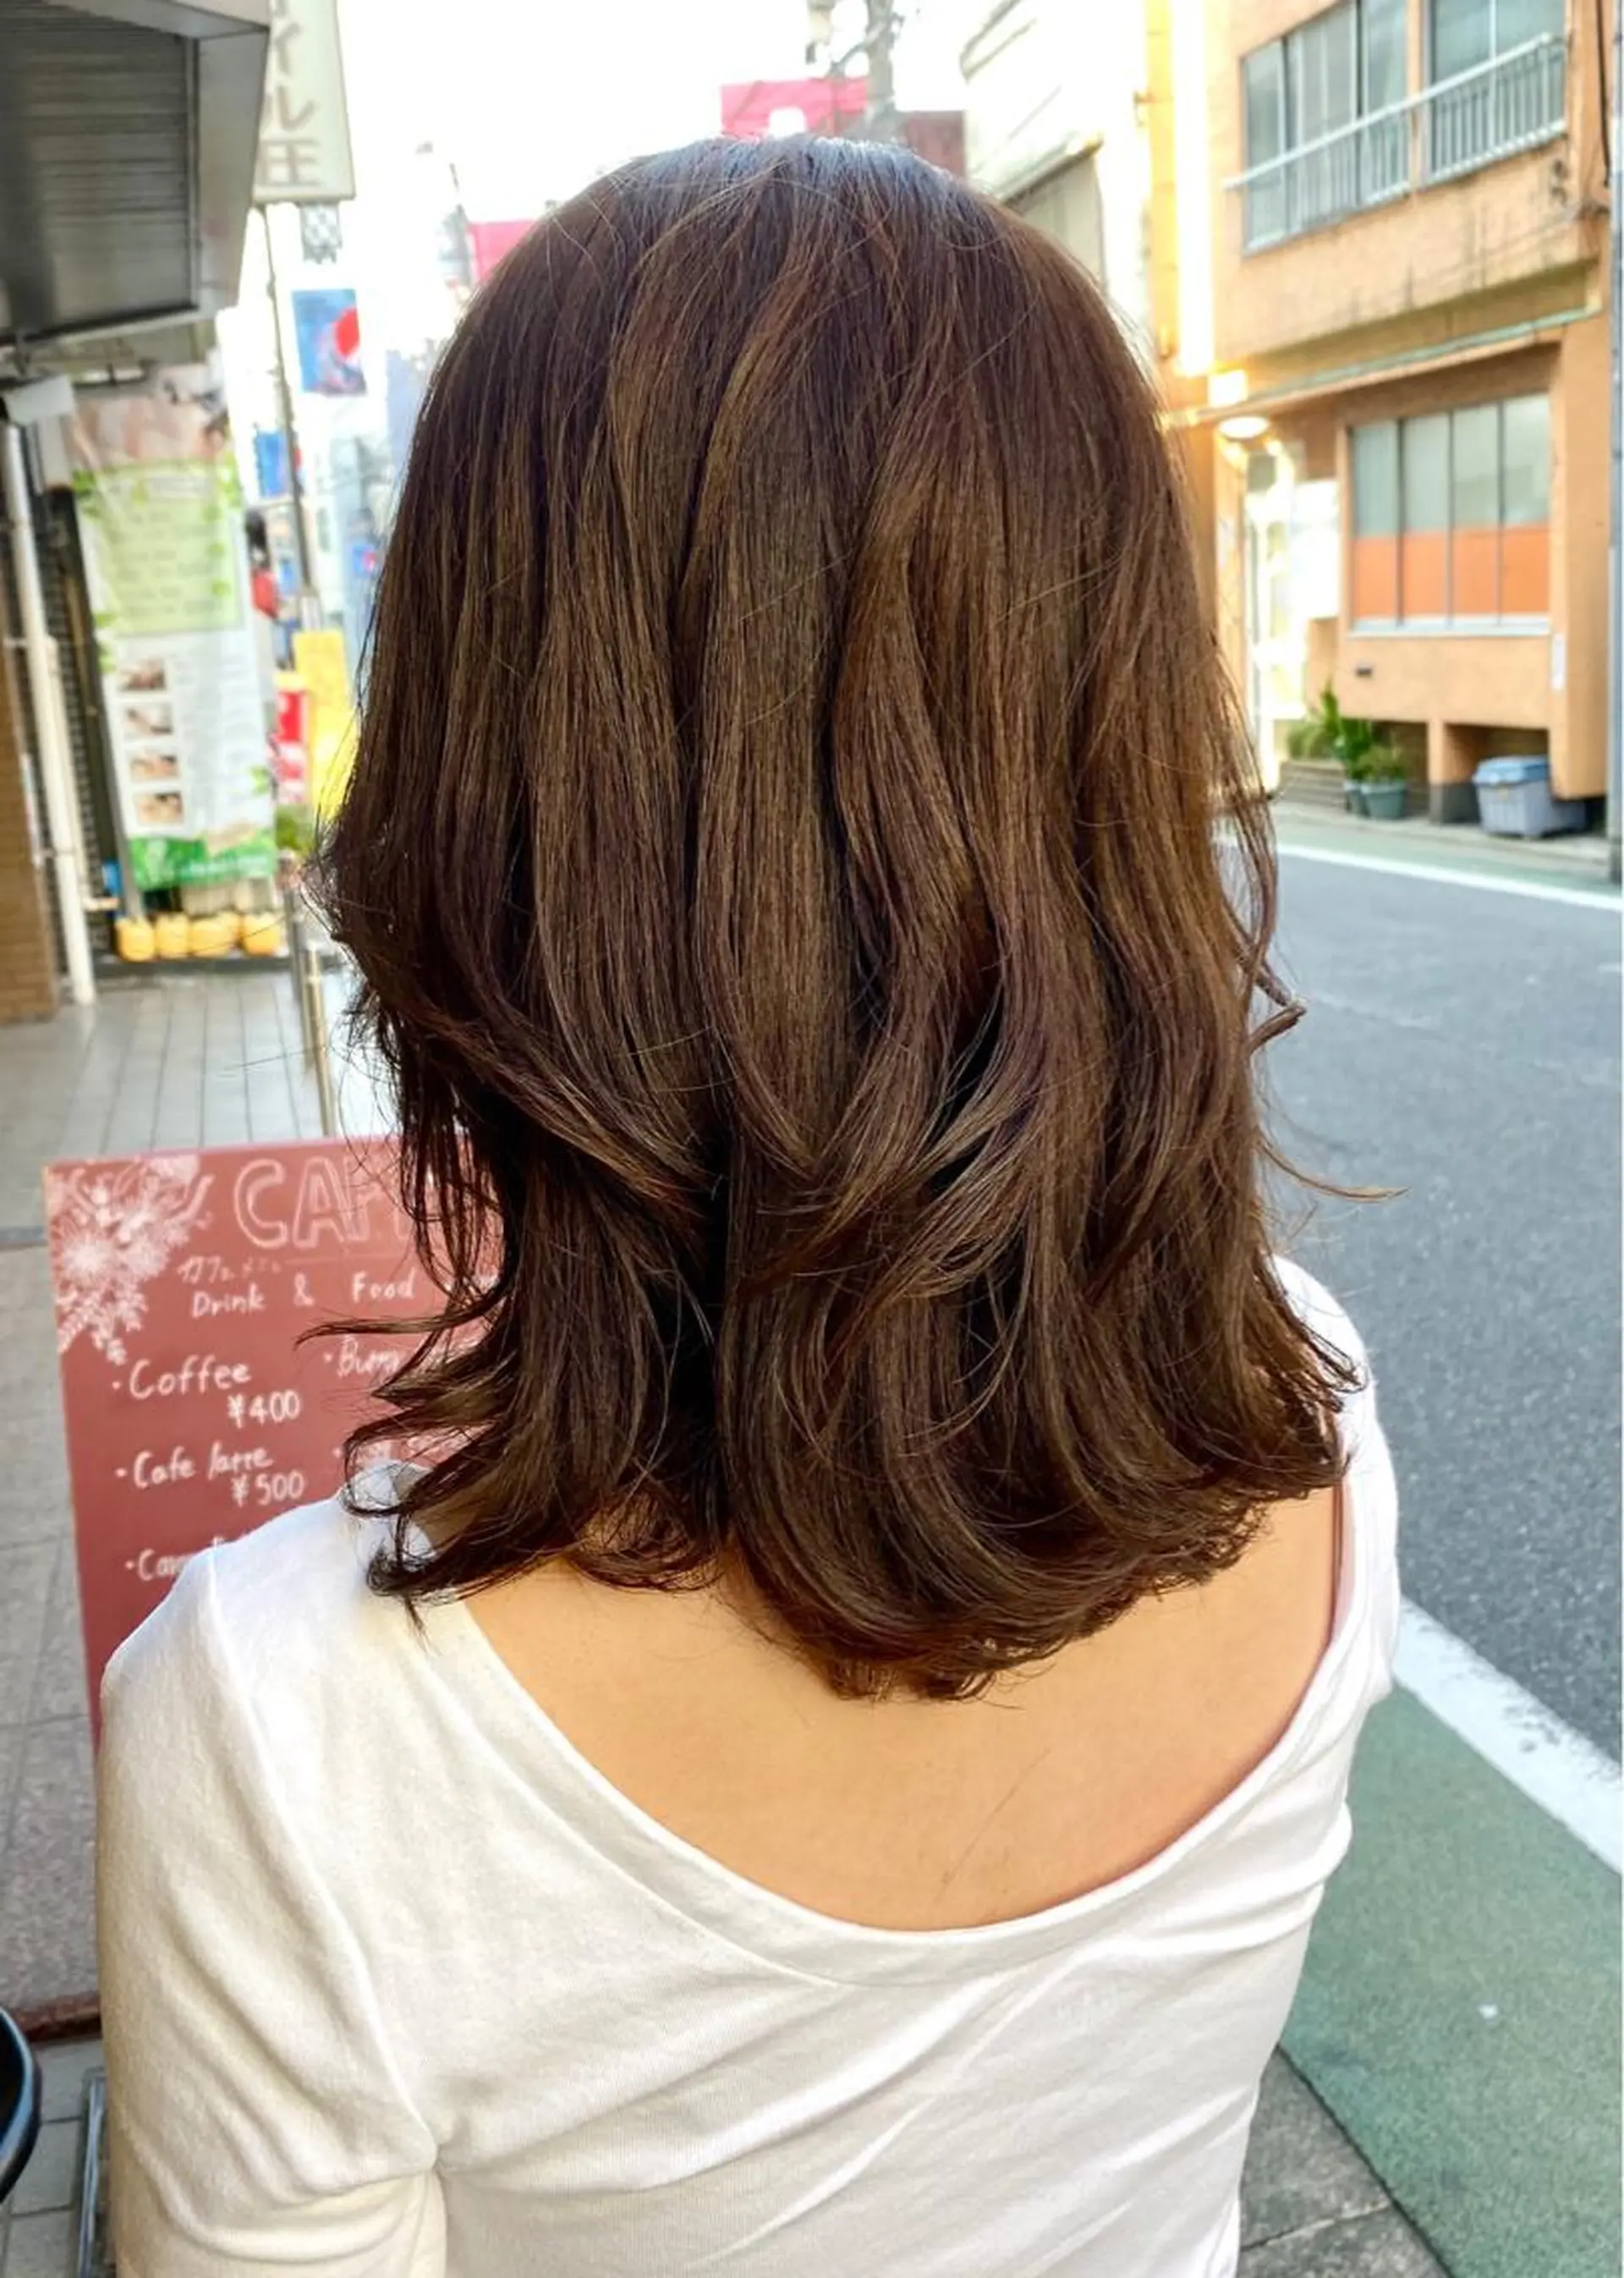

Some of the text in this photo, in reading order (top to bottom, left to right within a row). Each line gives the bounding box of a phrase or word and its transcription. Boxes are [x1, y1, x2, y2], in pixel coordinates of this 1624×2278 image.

[192, 1269, 416, 1318] Drink & Food
[129, 1354, 252, 1399] Coffee
[227, 1389, 301, 1429] ¥400
[134, 1445, 196, 1489] Cafe
[230, 1468, 305, 1507] ¥500
